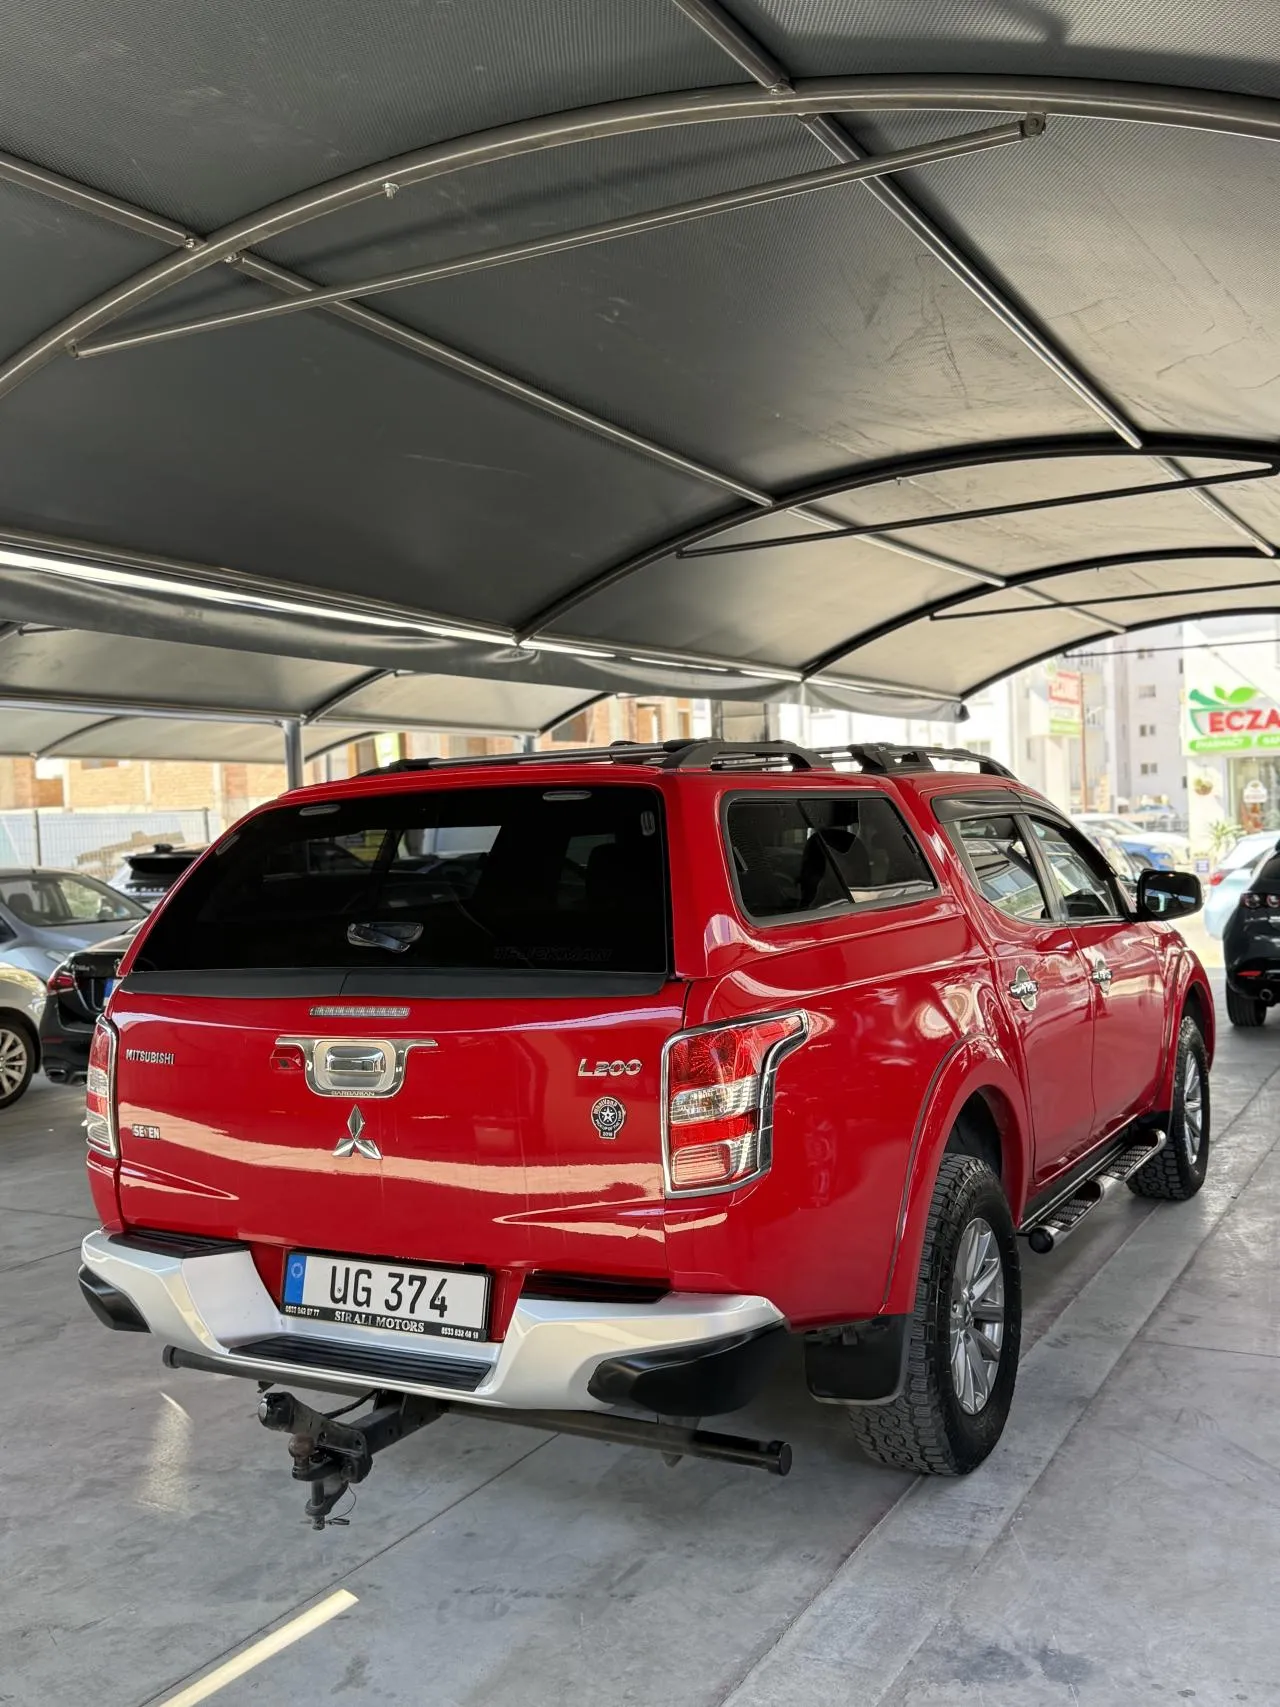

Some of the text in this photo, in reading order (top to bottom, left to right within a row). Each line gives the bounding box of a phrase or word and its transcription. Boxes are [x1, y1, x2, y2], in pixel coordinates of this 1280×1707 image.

[1208, 709, 1280, 733] ECZA
[126, 1049, 175, 1065] MITSUBISHI
[577, 1058, 643, 1077] L200
[133, 1124, 160, 1139] SEVEN
[329, 1265, 448, 1318] UG 374
[376, 1316, 425, 1332] MOTORS
